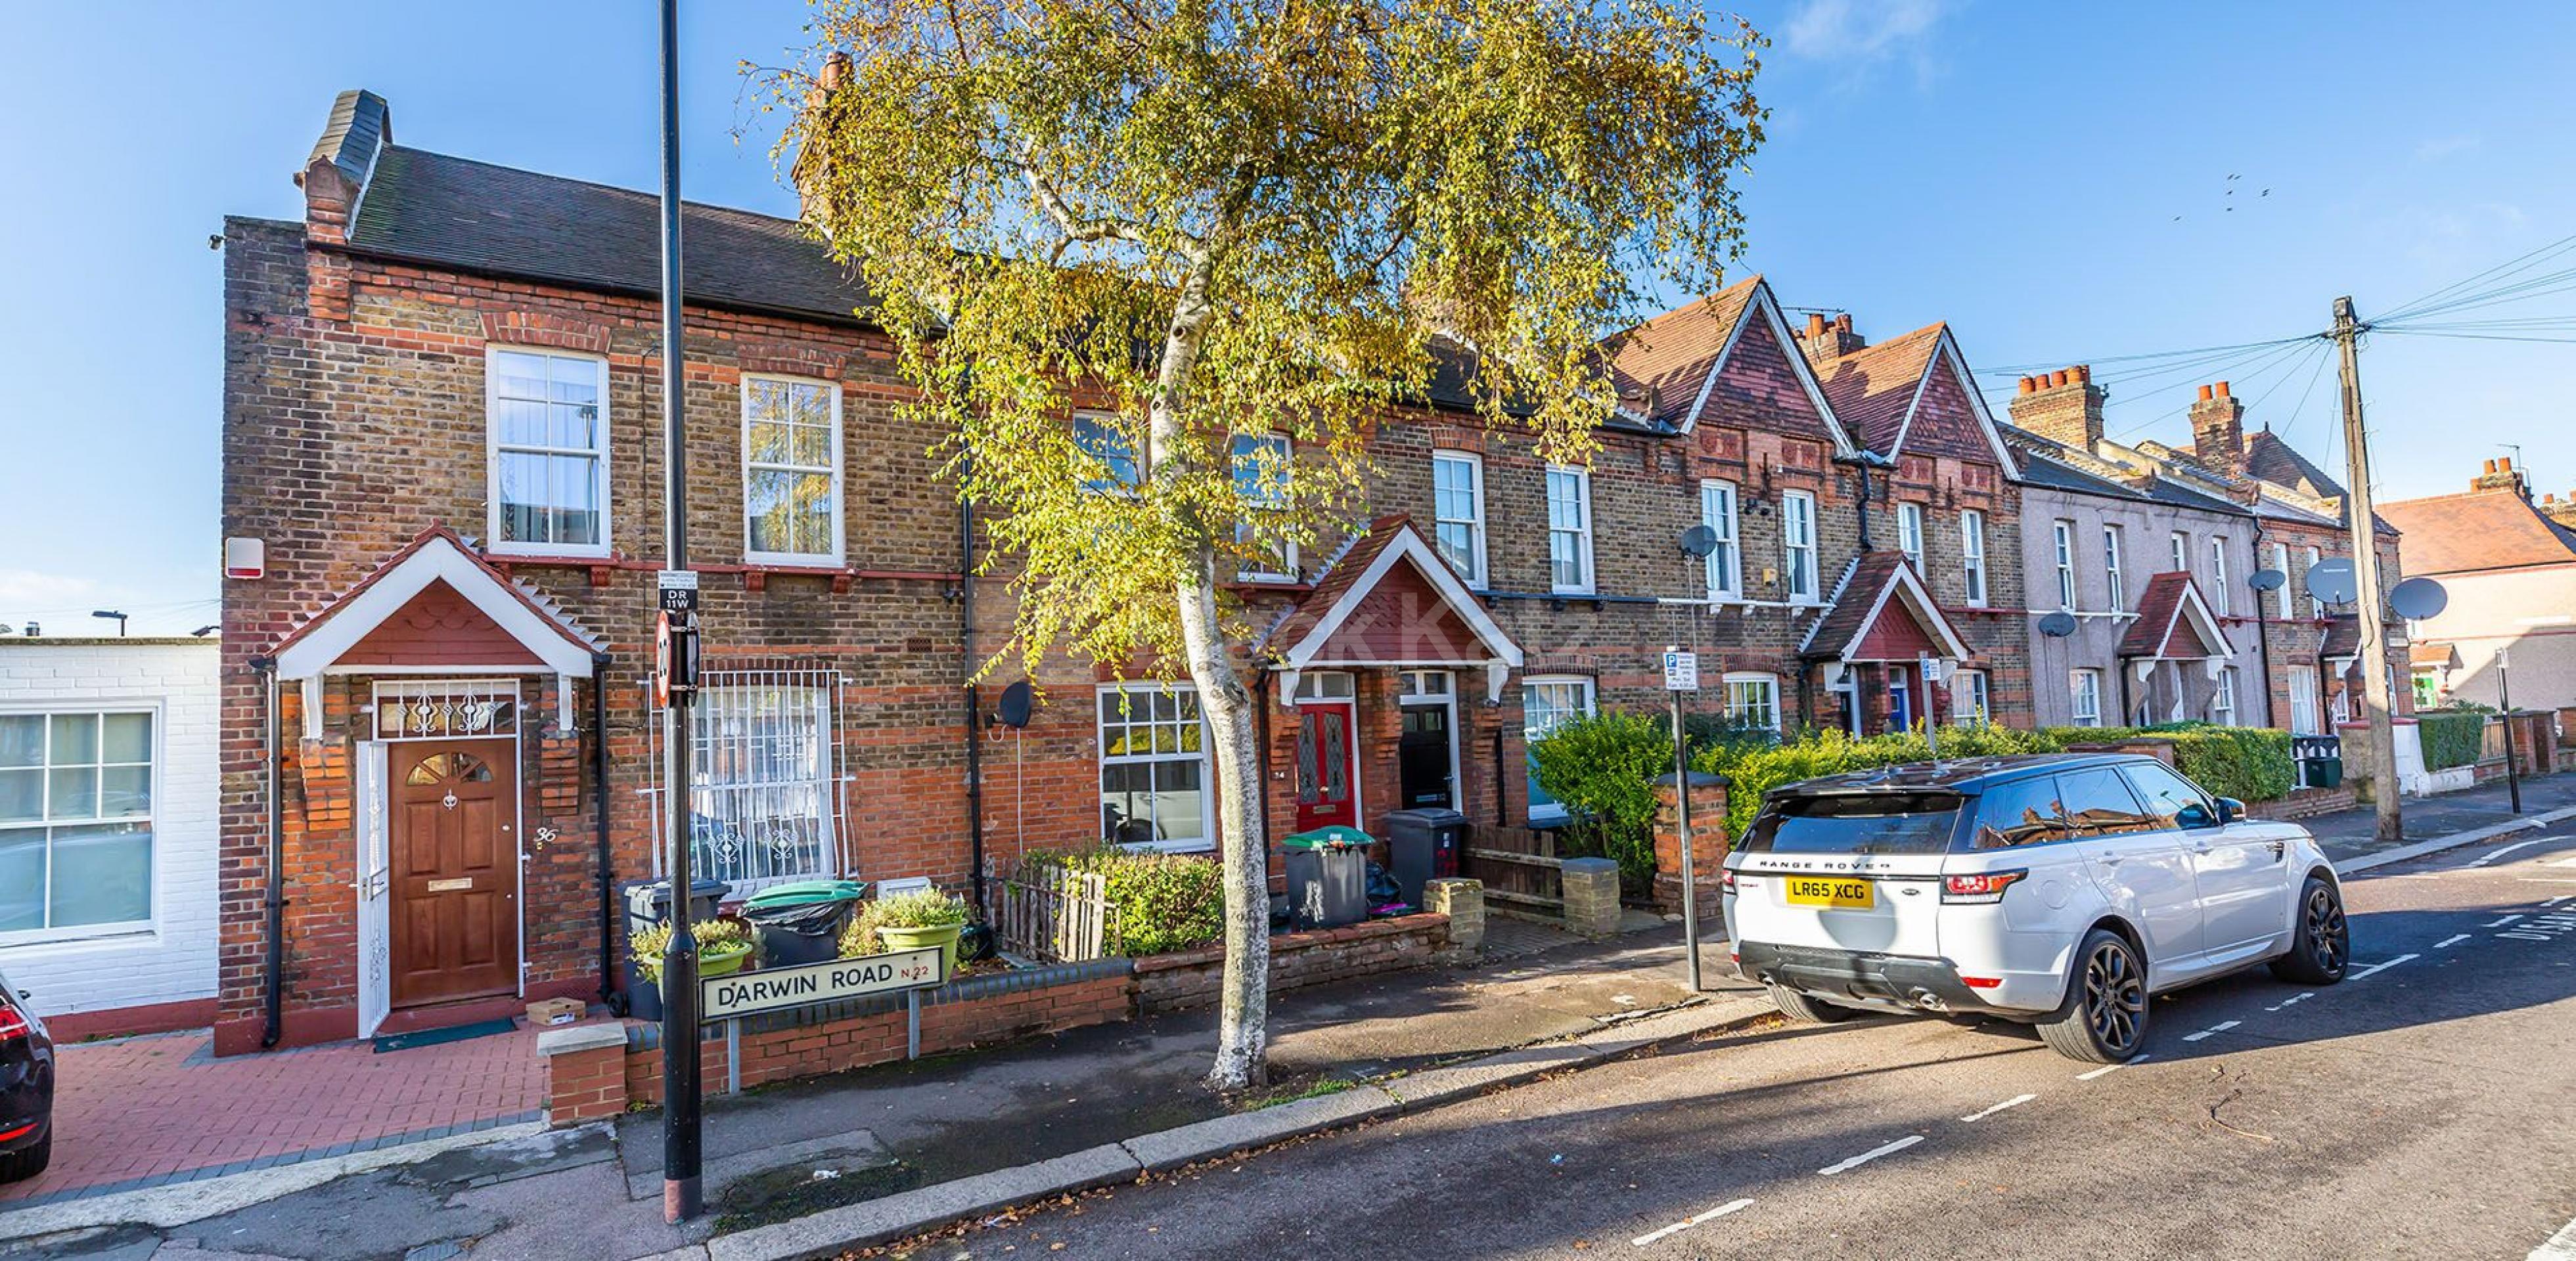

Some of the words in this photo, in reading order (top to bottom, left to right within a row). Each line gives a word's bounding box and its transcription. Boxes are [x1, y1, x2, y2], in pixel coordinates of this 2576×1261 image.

[668, 590, 687, 599] DR
[666, 600, 689, 608] 11W
[533, 827, 559, 841] 36
[1792, 881, 1830, 896] LR65
[1834, 883, 1864, 899] XCG
[719, 974, 817, 1007] DARWIN
[831, 963, 893, 989] ROAD
